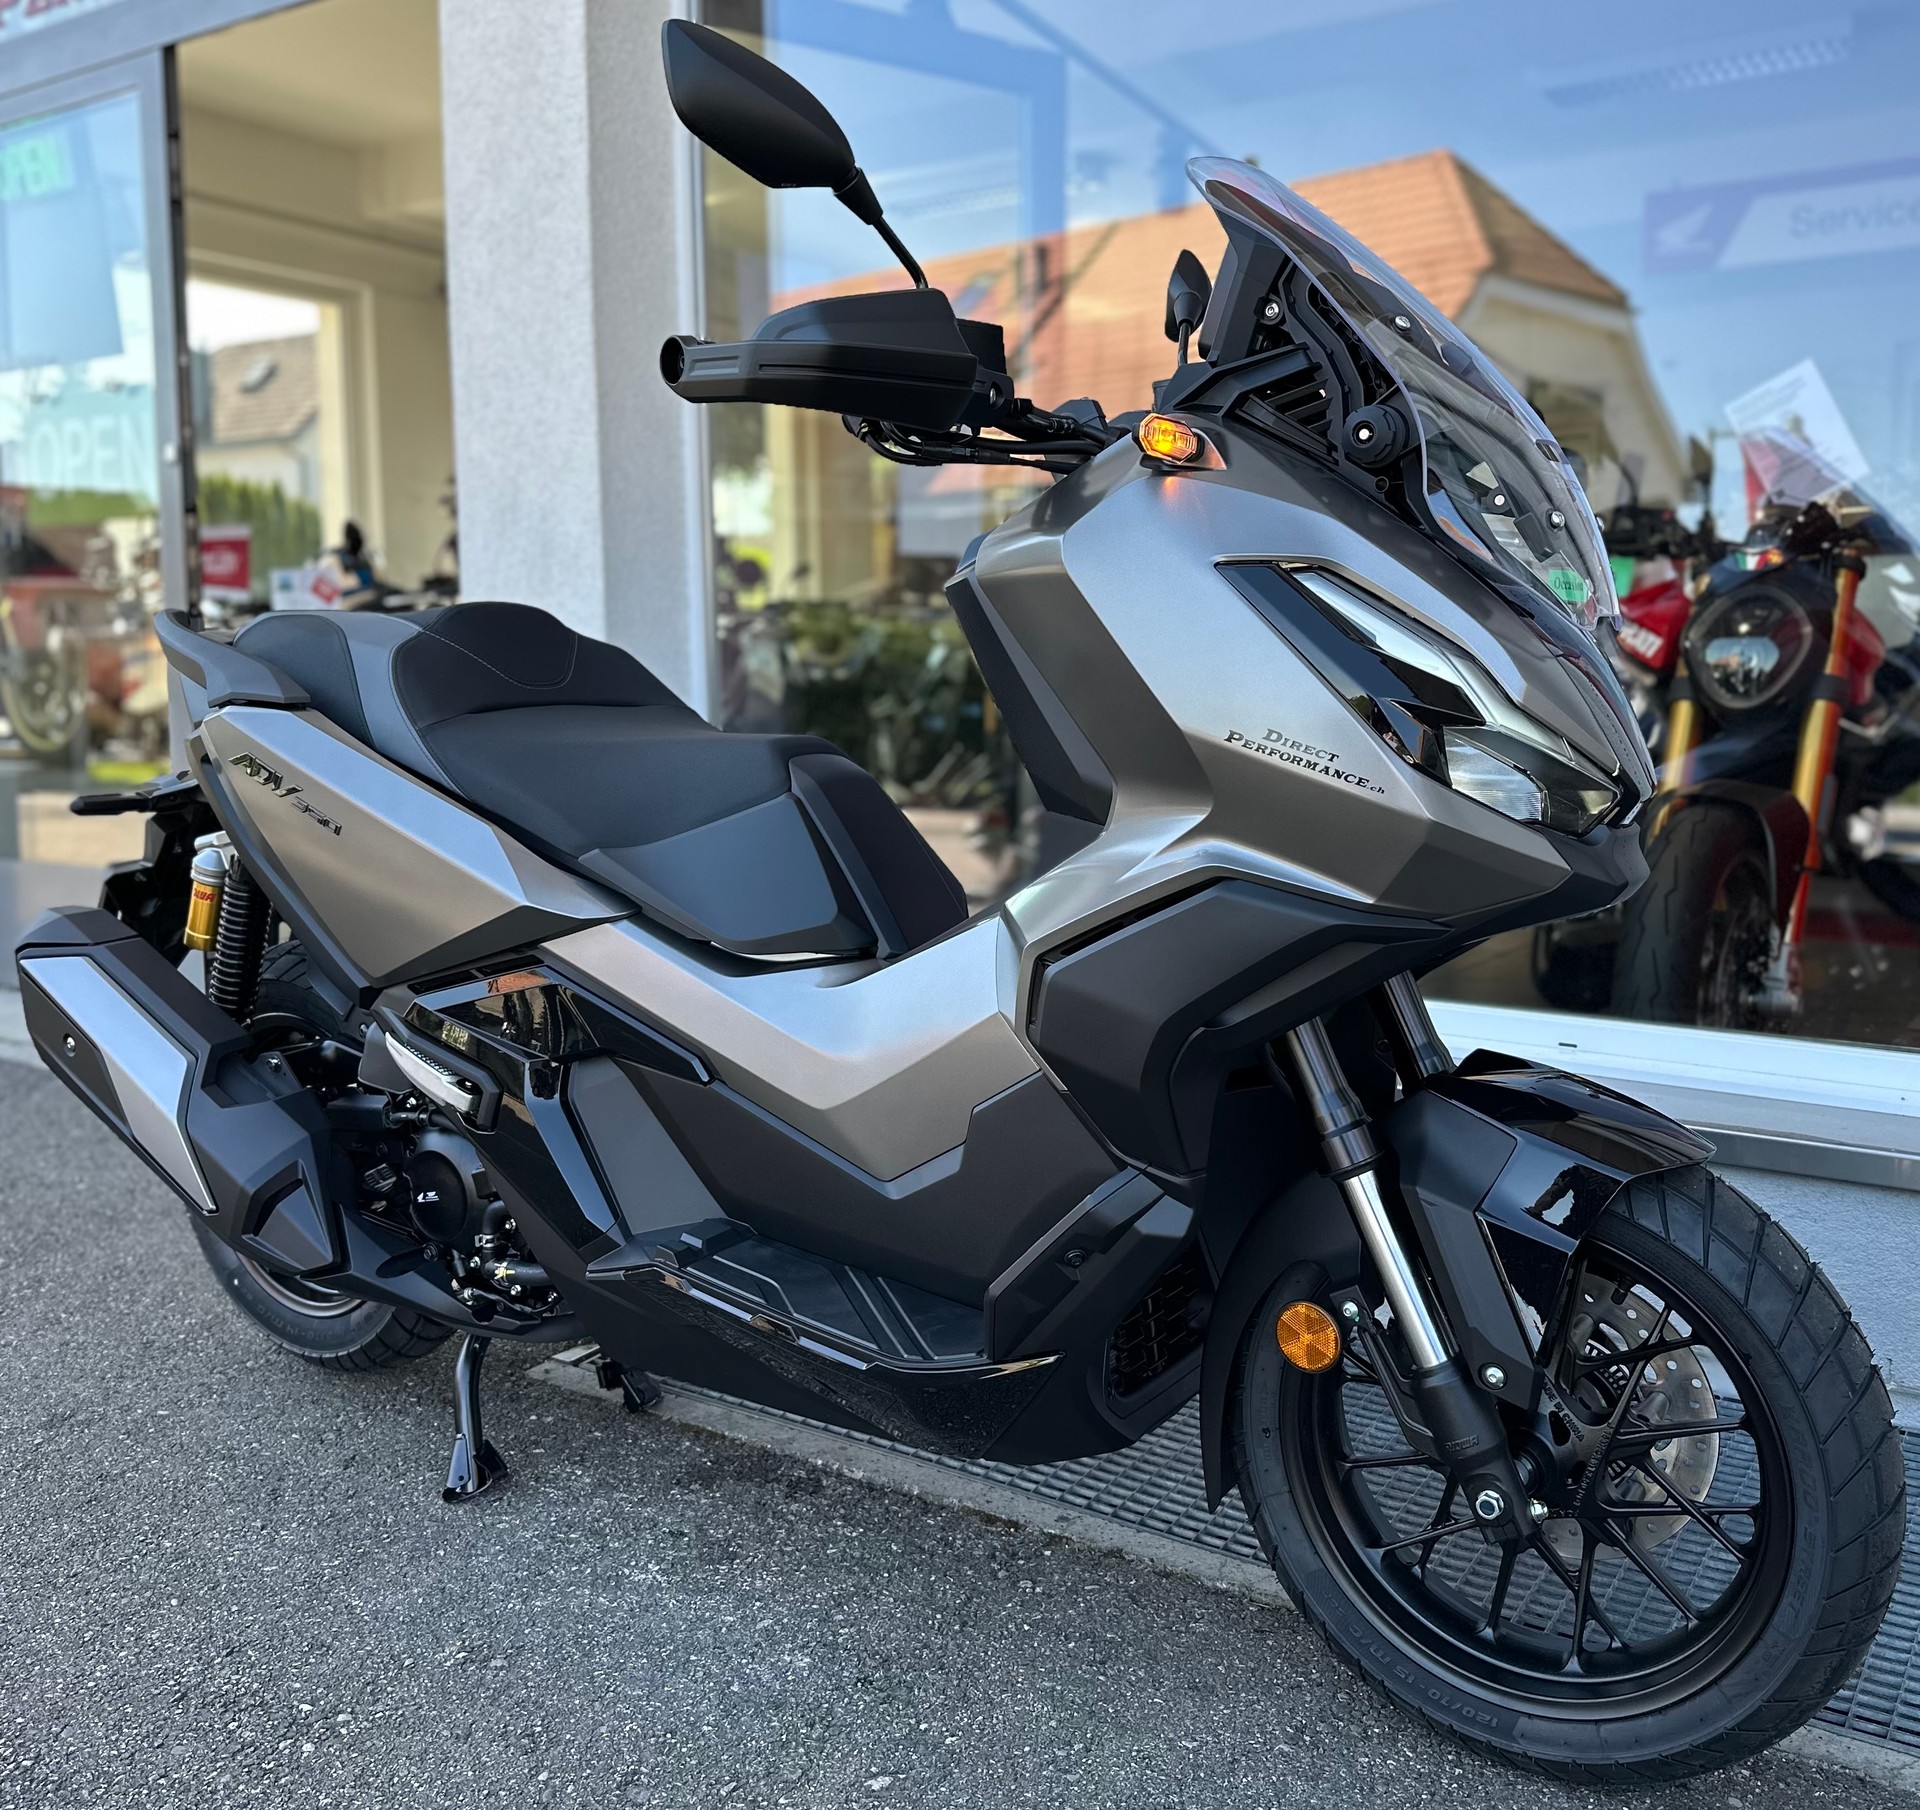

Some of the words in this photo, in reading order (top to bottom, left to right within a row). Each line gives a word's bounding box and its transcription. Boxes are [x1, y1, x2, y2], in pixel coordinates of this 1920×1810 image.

[30, 413, 160, 505] OPEN
[1223, 729, 1386, 795] PERFORMANCE.ch
[1262, 728, 1340, 763] DIRECT
[228, 751, 304, 798] ADV
[290, 795, 343, 836] 350
[1562, 1412, 1585, 1442] CHINA
